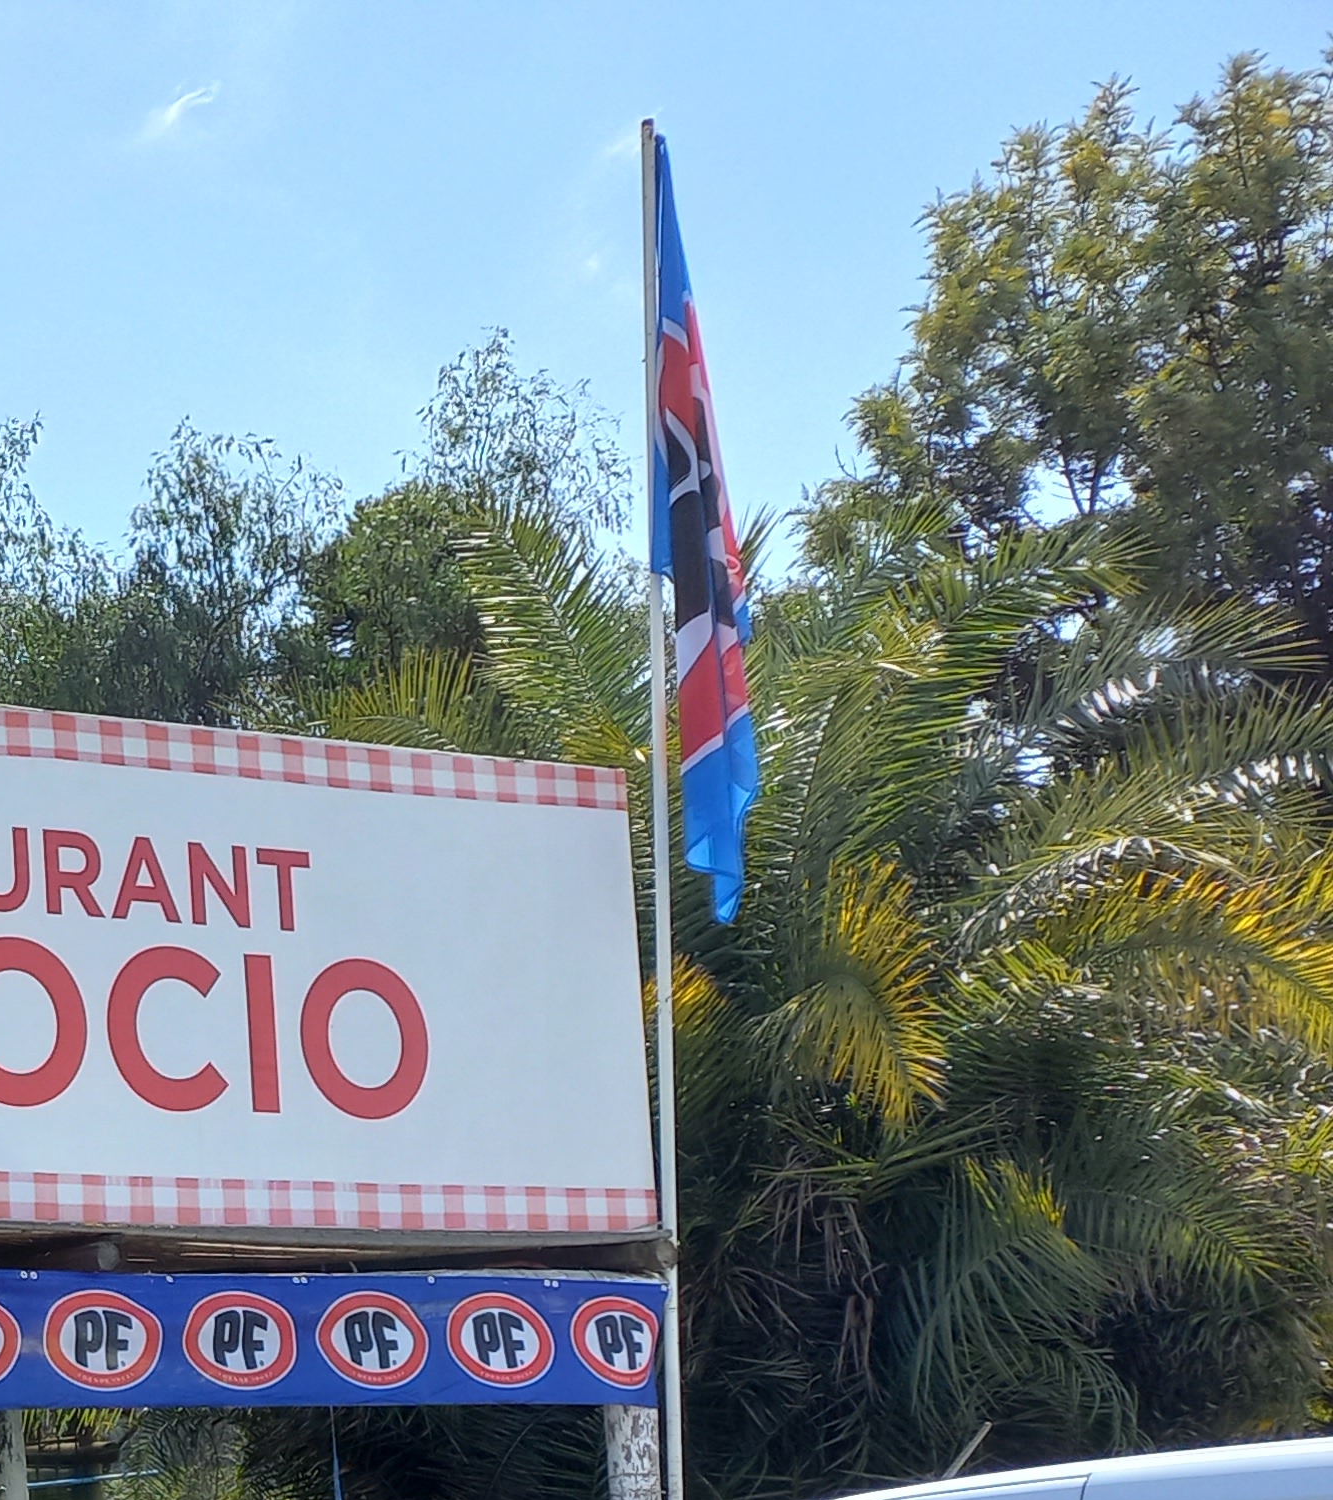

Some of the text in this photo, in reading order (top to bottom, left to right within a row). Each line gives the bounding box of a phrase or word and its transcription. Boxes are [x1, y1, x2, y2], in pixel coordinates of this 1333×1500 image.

[73, 1309, 134, 1371] PF
[212, 1309, 269, 1370] PF
[344, 1311, 399, 1369] PF
[471, 1311, 526, 1369] PF
[594, 1314, 645, 1371] PF
